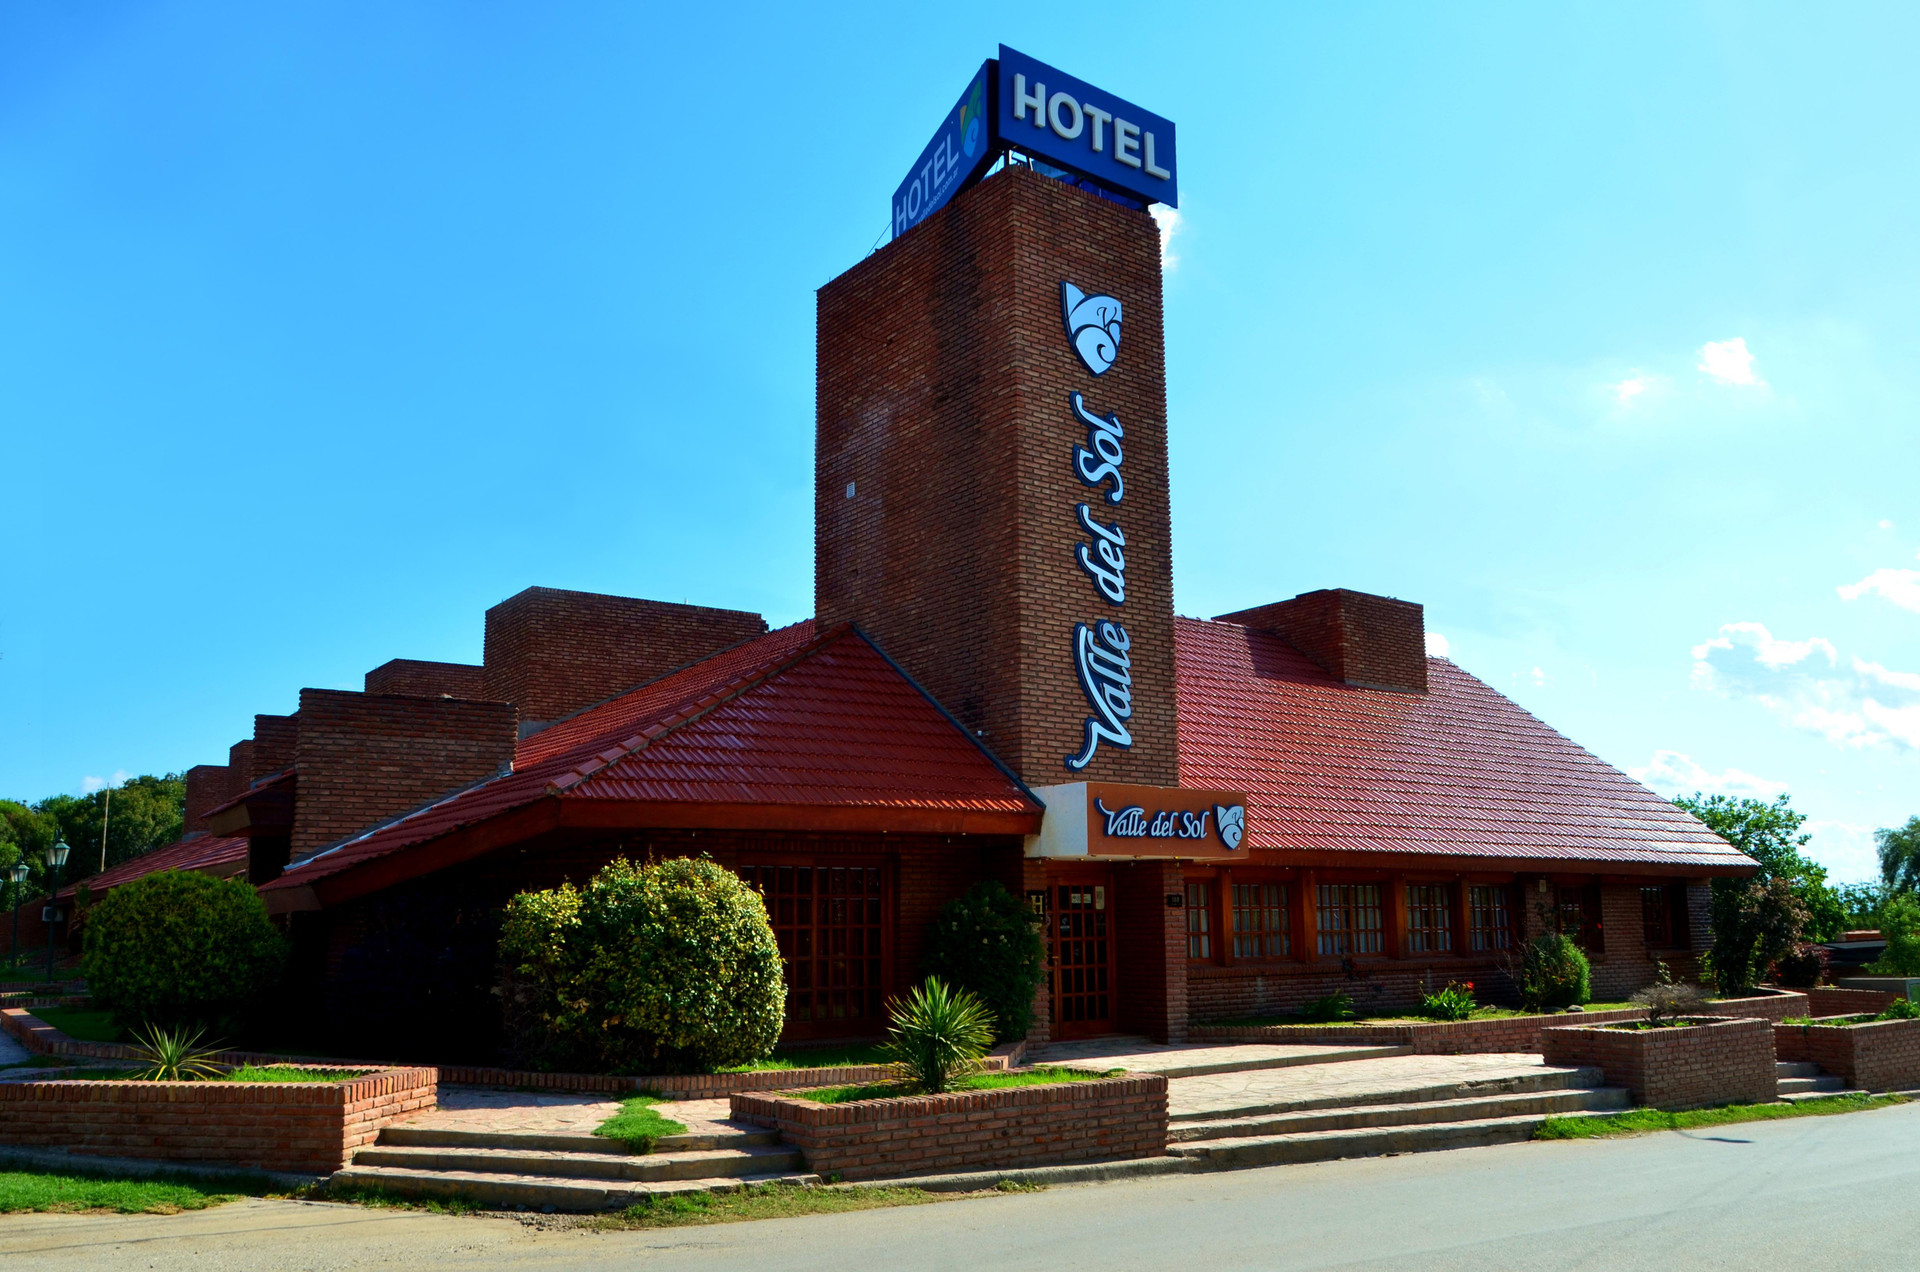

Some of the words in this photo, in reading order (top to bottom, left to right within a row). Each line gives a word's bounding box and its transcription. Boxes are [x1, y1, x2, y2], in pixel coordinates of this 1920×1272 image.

[1013, 72, 1171, 181] HOTEL
[896, 132, 960, 238] HOTEL
[1072, 391, 1124, 505] Sol
[1077, 503, 1126, 606] del
[1068, 619, 1130, 769] Valle
[1095, 797, 1146, 837] Valle
[1149, 811, 1178, 837] del
[1178, 811, 1209, 839] Sol
[1030, 894, 1044, 915] H
